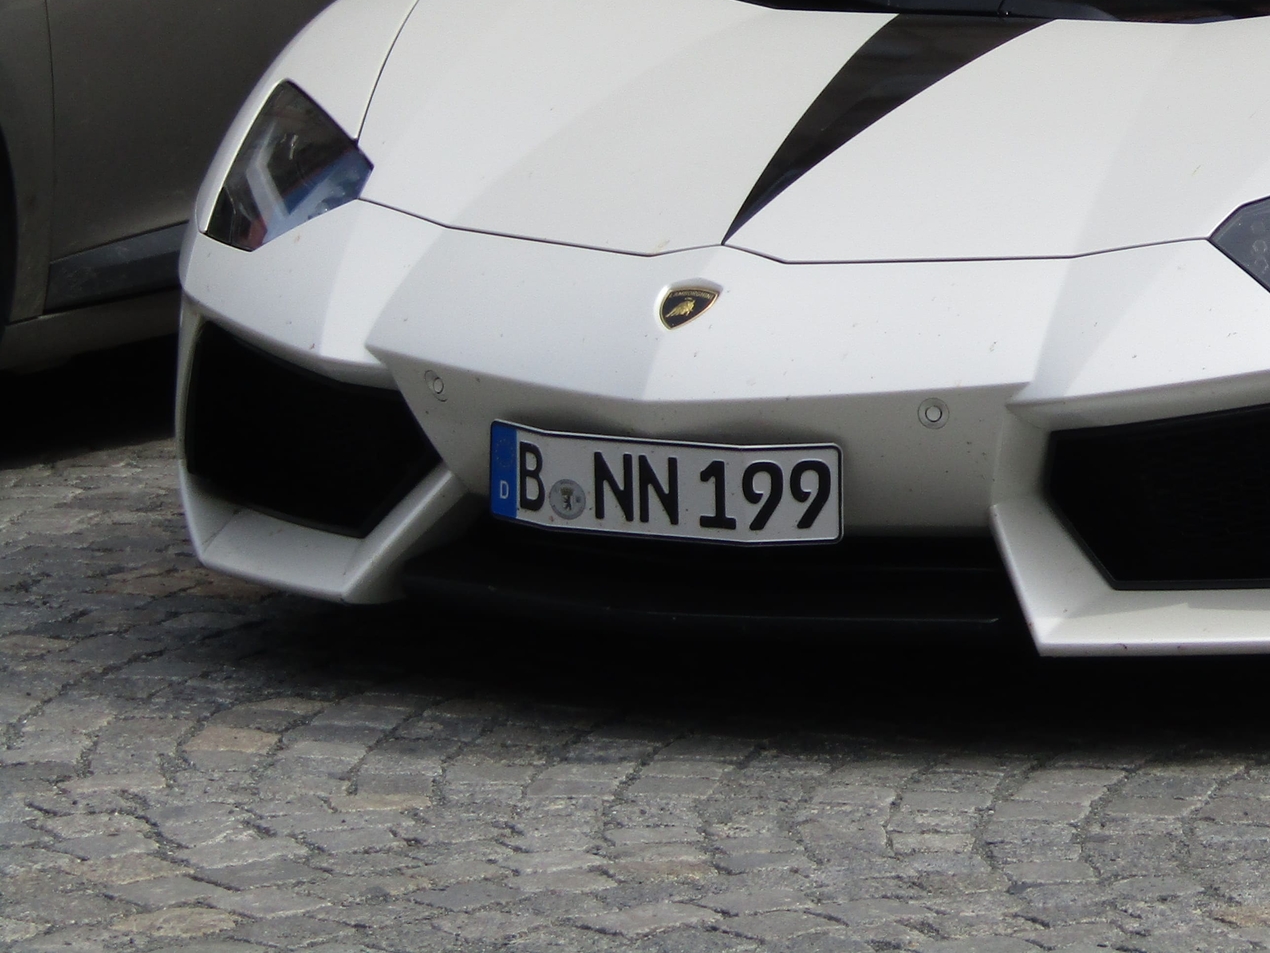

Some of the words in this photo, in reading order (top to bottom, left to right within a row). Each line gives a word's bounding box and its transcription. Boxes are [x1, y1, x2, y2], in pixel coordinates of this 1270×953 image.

[499, 479, 509, 499] D
[519, 441, 545, 511] B
[594, 452, 679, 525] NN
[699, 459, 831, 530] 199
